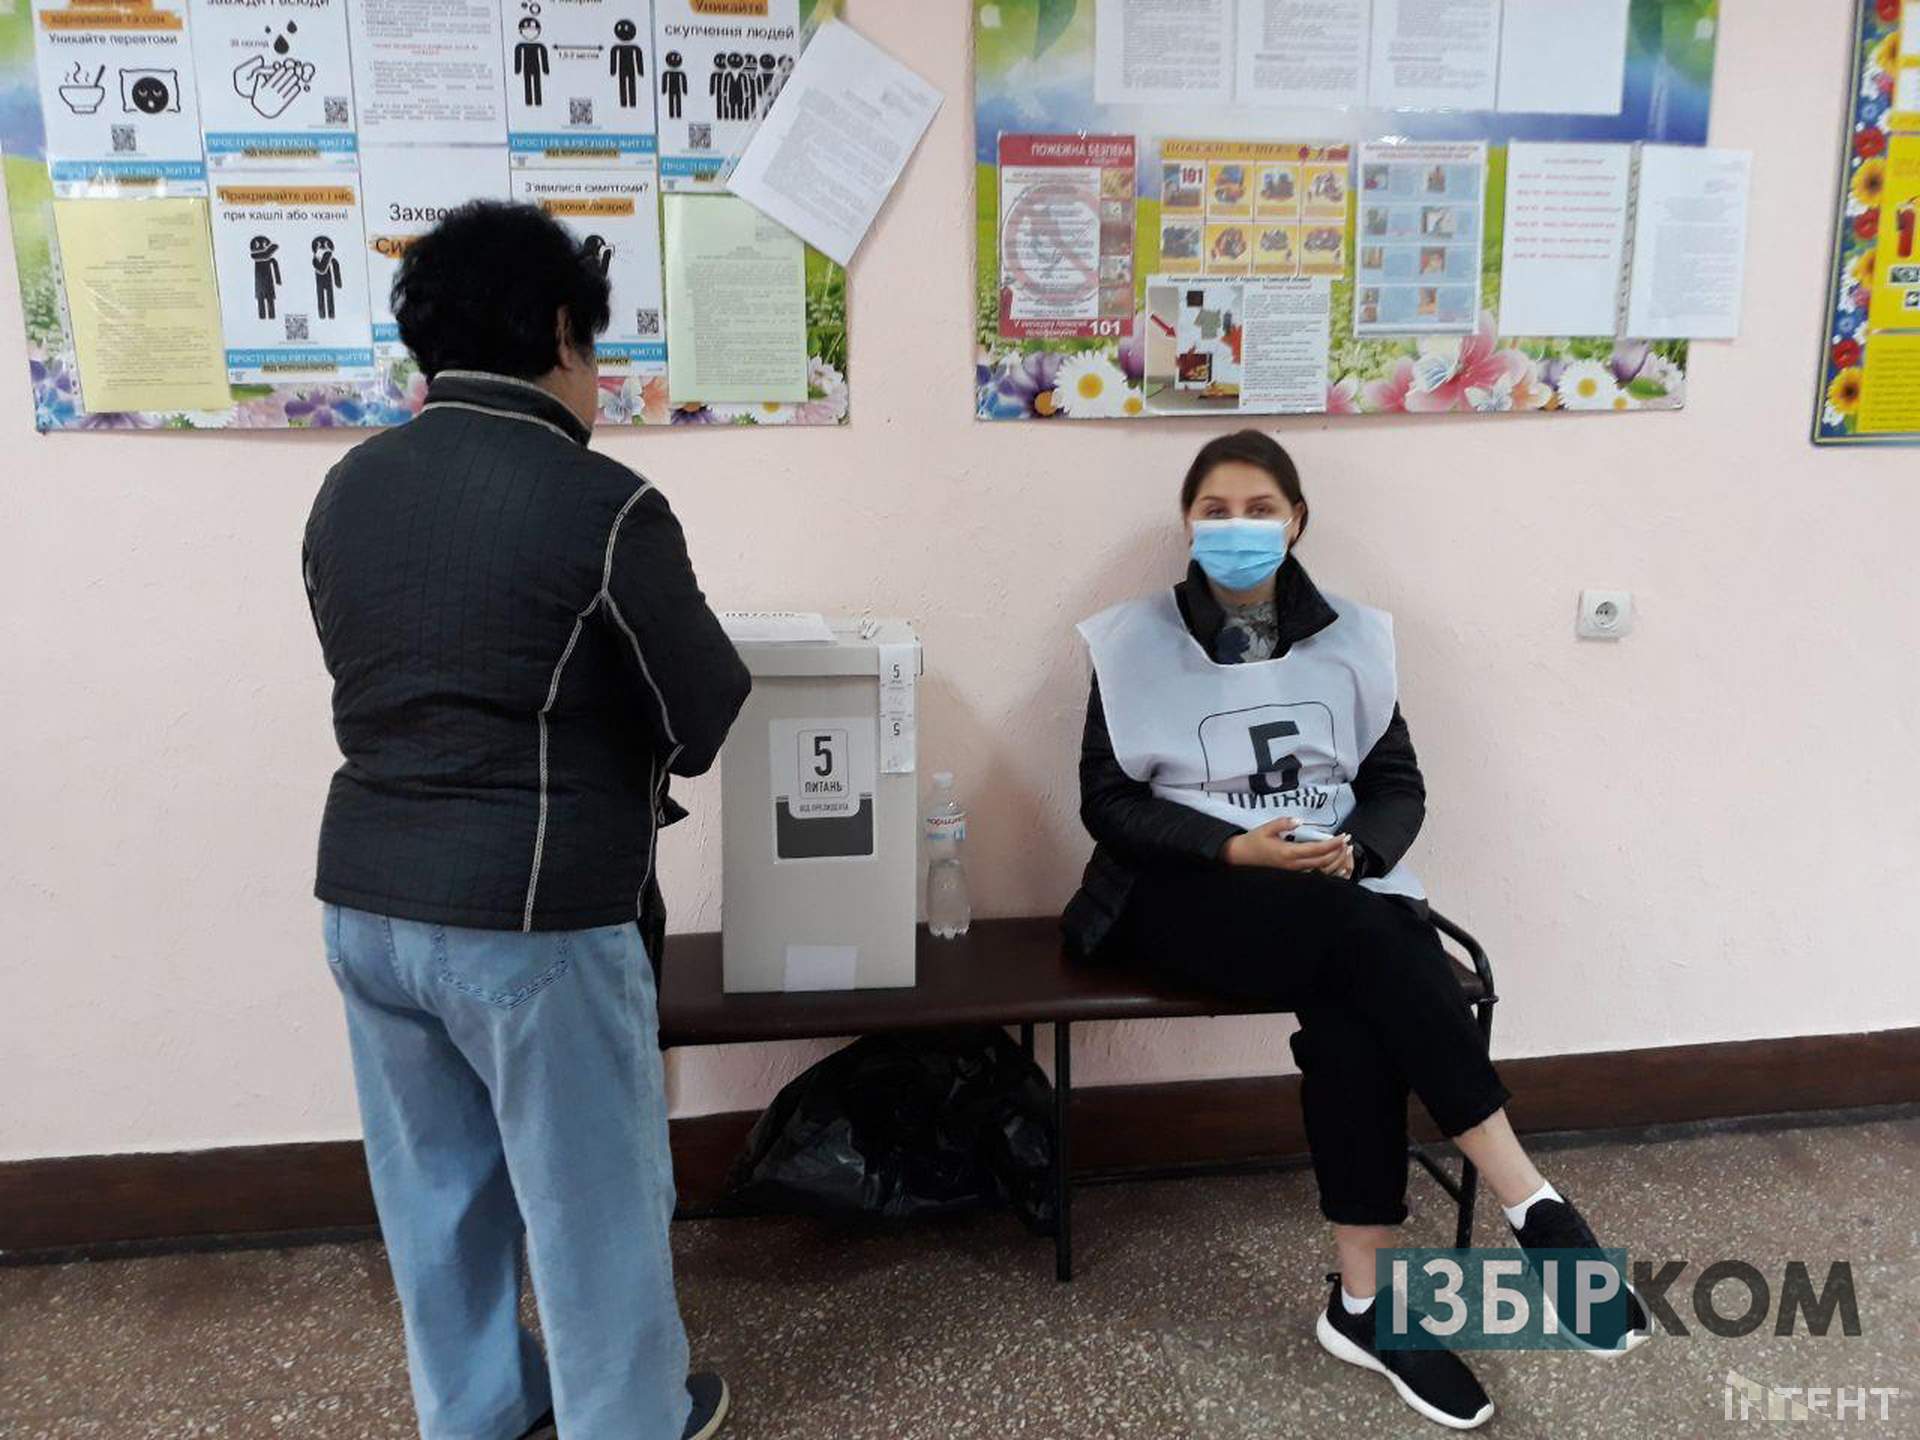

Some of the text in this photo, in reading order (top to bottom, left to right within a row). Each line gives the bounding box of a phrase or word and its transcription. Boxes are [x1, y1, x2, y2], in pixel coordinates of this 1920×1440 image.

[663, 24, 795, 40] скупчення людей
[1182, 167, 1203, 184] 101
[223, 211, 246, 222] при
[249, 209, 283, 221] кашлі
[286, 209, 308, 220] або
[389, 203, 450, 223] Захво
[375, 238, 404, 255] Си
[1090, 320, 1121, 337] 101
[893, 664, 901, 679] 5
[813, 735, 833, 777] 5
[1248, 720, 1303, 796] 5
[805, 781, 843, 793] ПИТАНЬ
